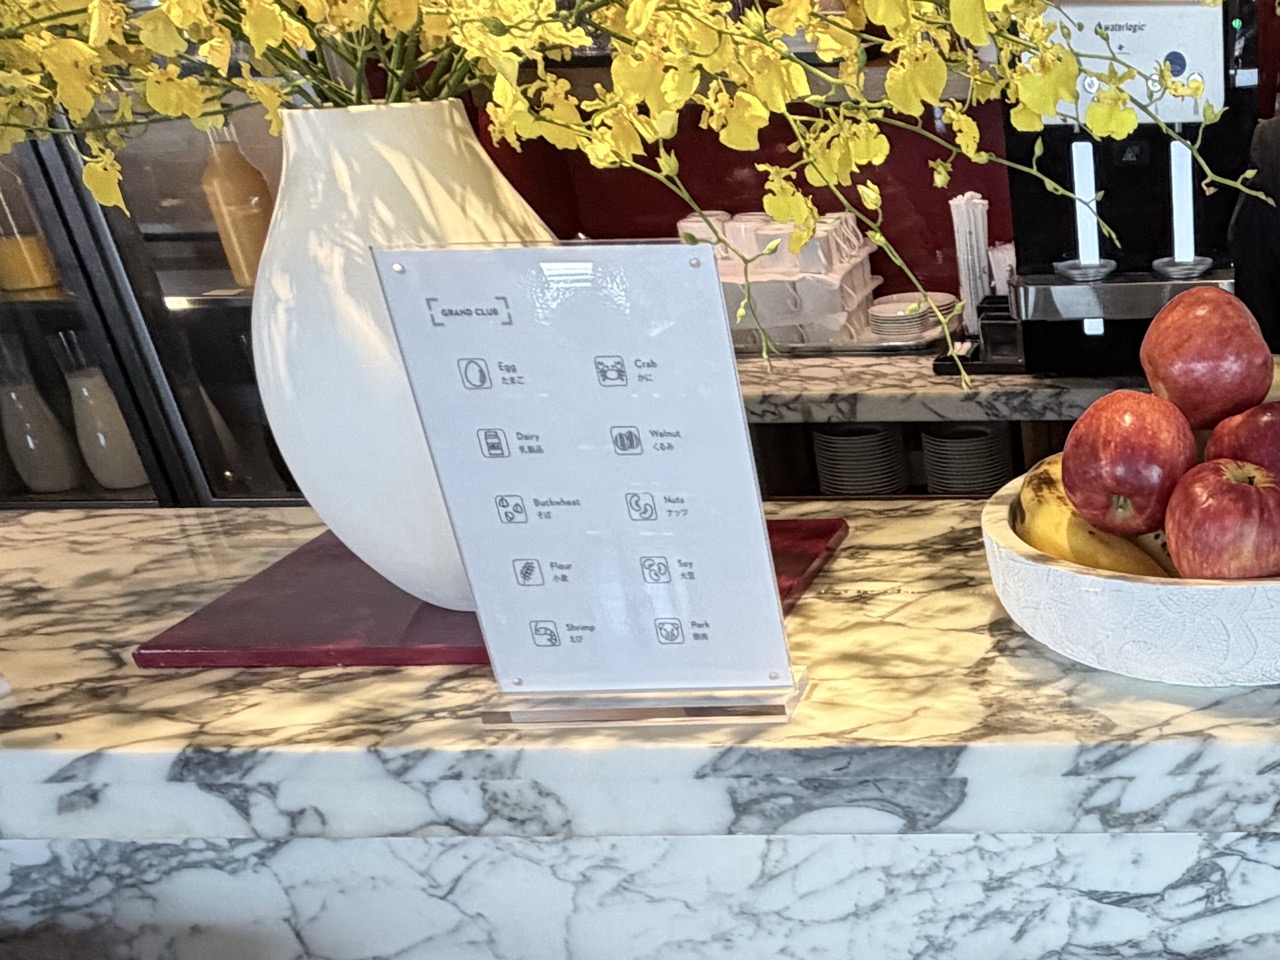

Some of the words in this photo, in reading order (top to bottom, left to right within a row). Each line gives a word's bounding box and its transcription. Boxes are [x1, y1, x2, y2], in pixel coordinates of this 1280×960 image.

[441, 308, 473, 316] GRAND
[475, 307, 499, 316] CLUB
[498, 361, 517, 373] Egg
[634, 359, 658, 368] Crab
[516, 431, 540, 442] Dairy
[649, 429, 682, 438] Walnut
[533, 498, 581, 507] Buckwheat
[664, 495, 685, 504] Nuts
[549, 561, 573, 570] Flour
[677, 559, 693, 569] Soy
[690, 620, 711, 629] Pork
